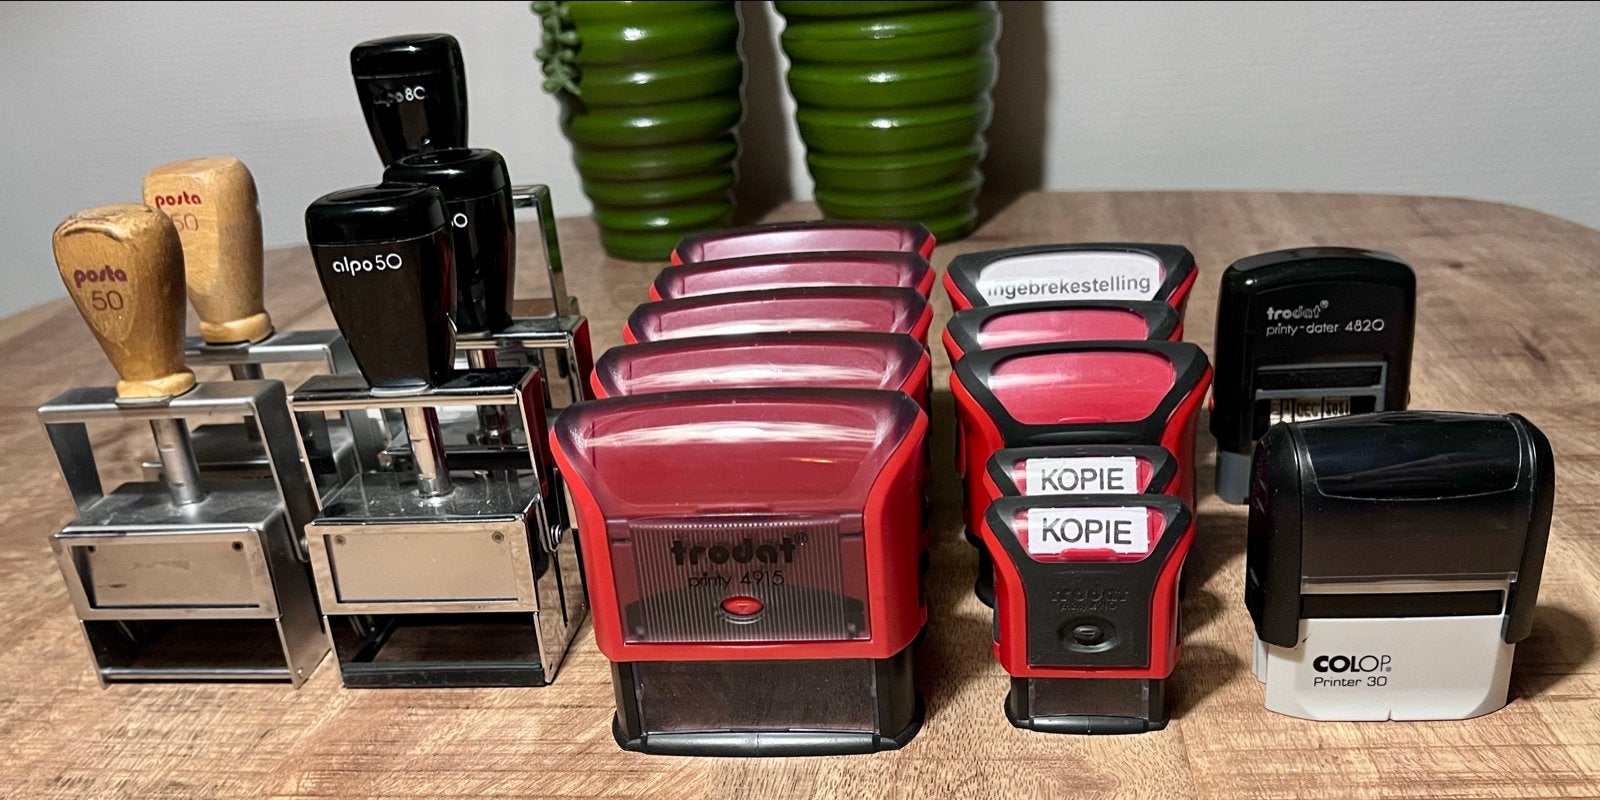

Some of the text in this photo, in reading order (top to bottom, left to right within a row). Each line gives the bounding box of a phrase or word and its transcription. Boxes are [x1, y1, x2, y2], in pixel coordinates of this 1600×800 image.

[155, 191, 202, 208] posta
[171, 213, 199, 232] 50
[74, 265, 127, 288] posta
[92, 290, 123, 311] 50
[1344, 318, 1385, 332] 4820
[1041, 467, 1125, 491] KOPIE
[1042, 517, 1132, 545] KOPIE
[688, 570, 785, 590] printy 4915
[1313, 675, 1388, 687] Printer 30
